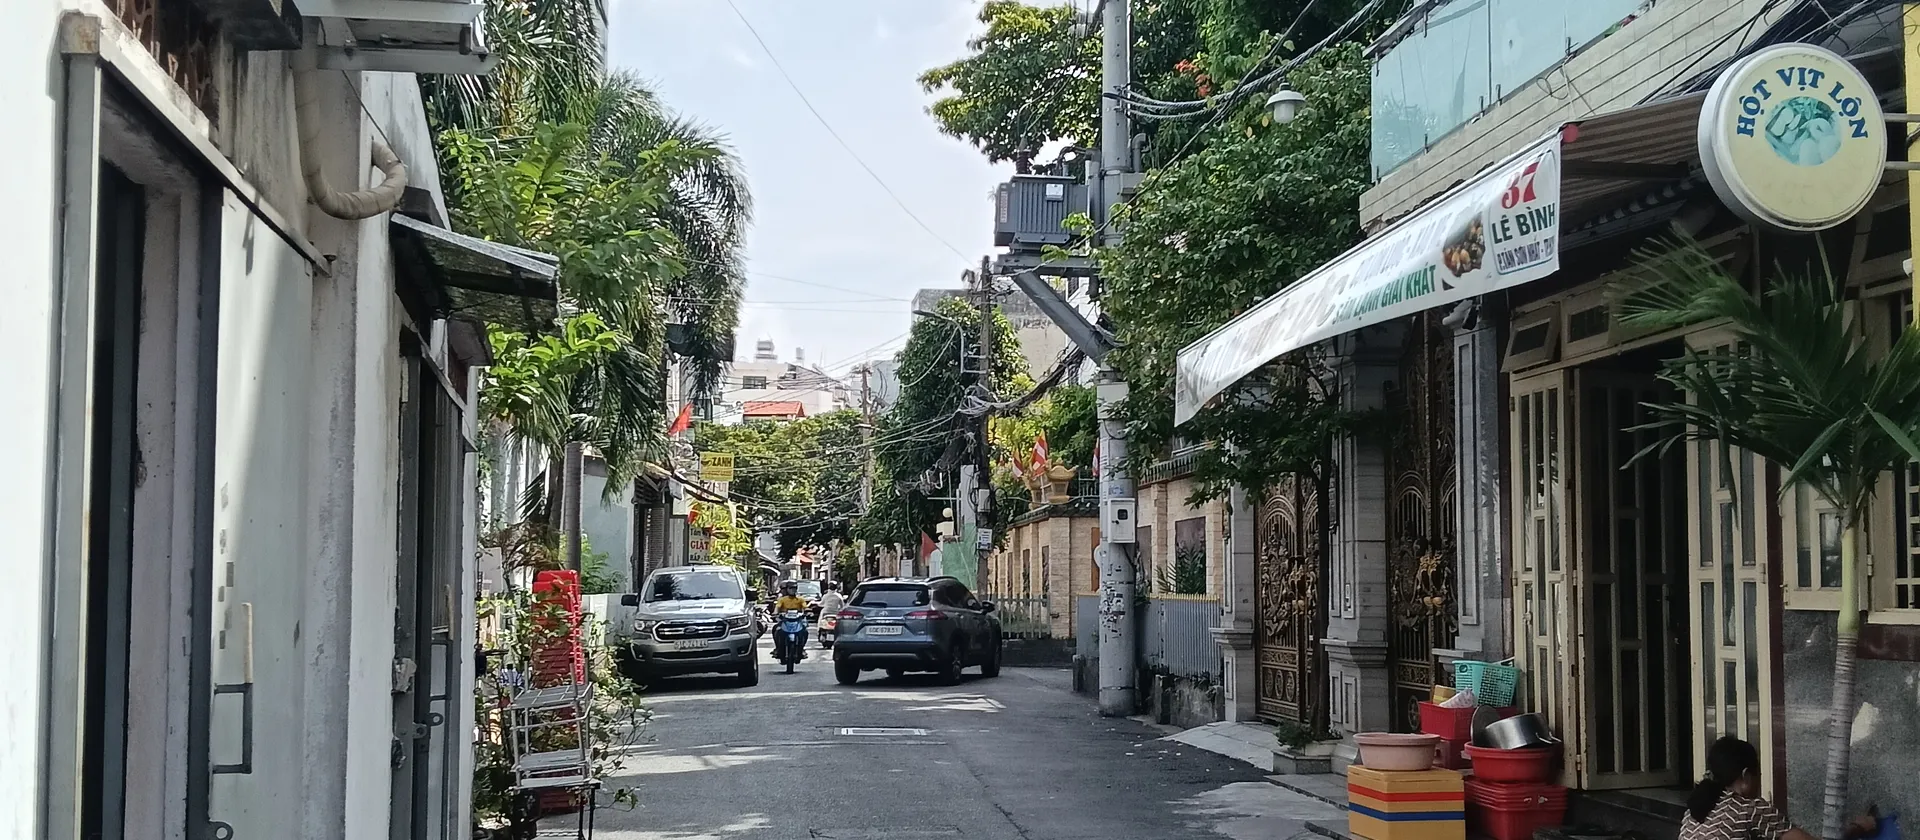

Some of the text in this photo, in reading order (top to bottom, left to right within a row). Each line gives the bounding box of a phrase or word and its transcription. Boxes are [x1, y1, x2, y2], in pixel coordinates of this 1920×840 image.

[1737, 67, 1868, 139] HỘT VỊT LỘN
[1501, 161, 1540, 209] 37
[1492, 203, 1556, 245] LÊ BÌNH
[1406, 261, 1436, 300] KHÁT
